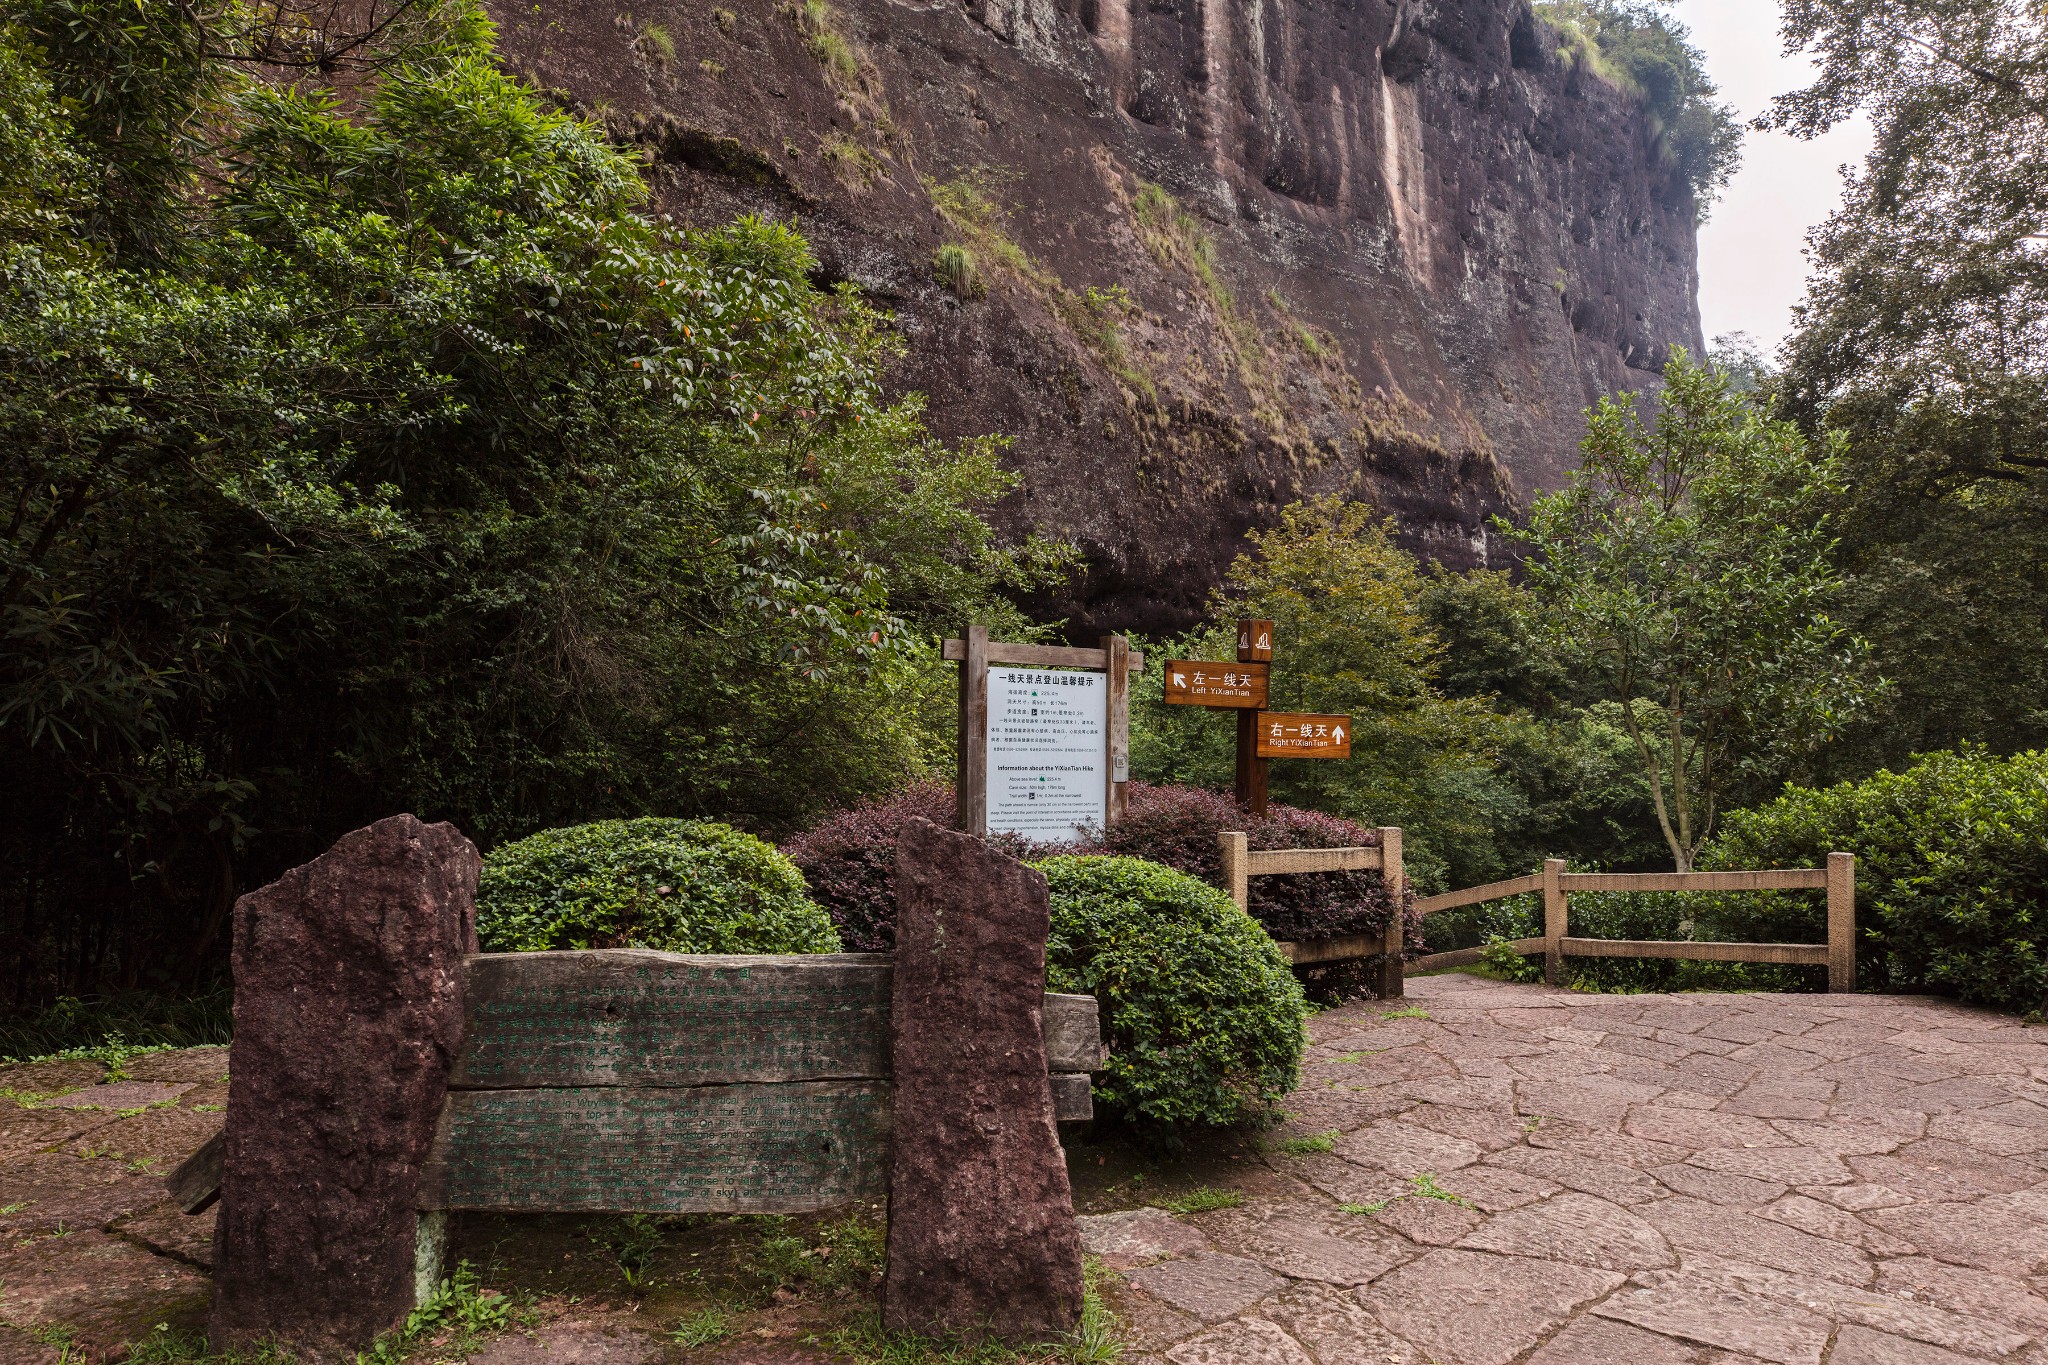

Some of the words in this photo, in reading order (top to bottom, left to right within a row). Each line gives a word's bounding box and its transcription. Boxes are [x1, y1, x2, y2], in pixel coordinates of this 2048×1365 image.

[999, 673, 1094, 686] 一线天景点登山温馨提示
[1192, 671, 1252, 688] 左一线天
[1191, 686, 1206, 695] Left
[1210, 687, 1250, 697] YiXianTian
[1270, 722, 1328, 738] 右一线天
[1269, 738, 1289, 748] Right
[1290, 738, 1328, 747] YiXianTian
